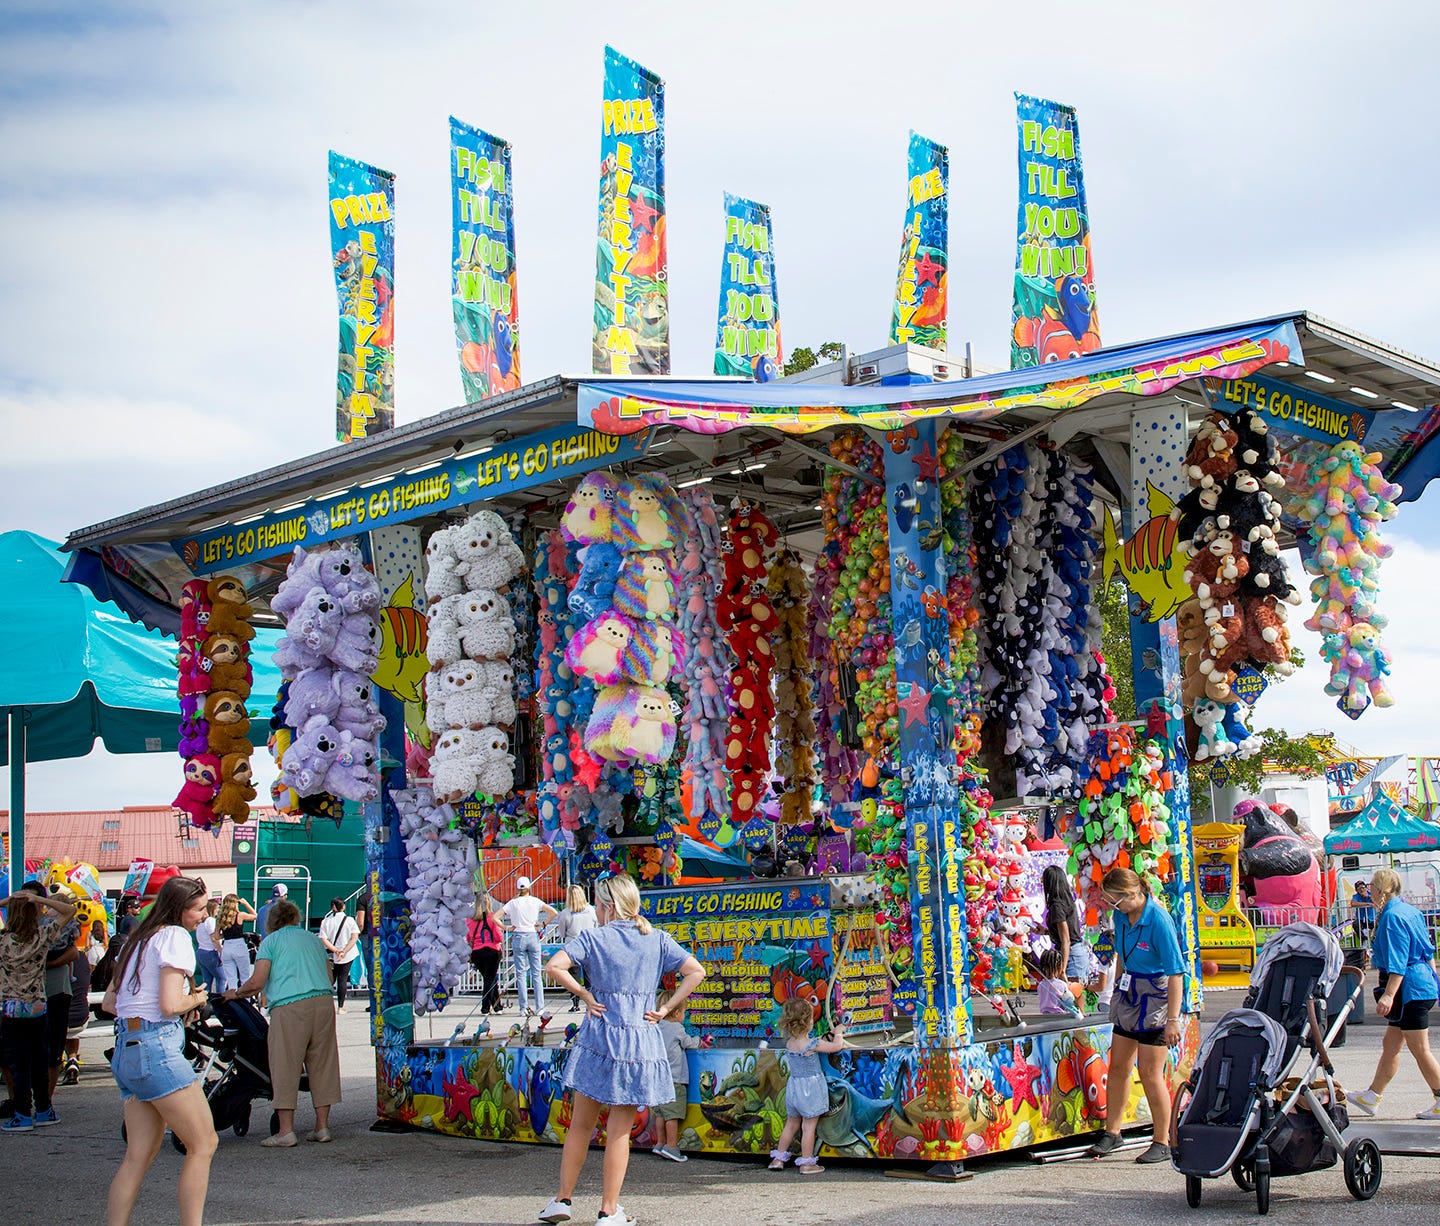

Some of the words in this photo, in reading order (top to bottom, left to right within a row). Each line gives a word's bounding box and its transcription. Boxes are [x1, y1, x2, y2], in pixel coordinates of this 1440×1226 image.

[602, 99, 659, 136] PRIZE
[1023, 120, 1076, 160] FISH
[456, 146, 506, 195] FISH
[909, 167, 947, 205] RIZE
[1026, 162, 1078, 199] TILL
[330, 192, 391, 229] PRIZE
[459, 191, 506, 232] TILL
[1025, 202, 1083, 239] YOU
[459, 230, 508, 273] YOU
[725, 214, 769, 253] FISH
[605, 142, 637, 374] EVERYTIME
[727, 252, 771, 286] TILL
[1021, 245, 1088, 279] WIN!
[457, 271, 512, 315] WIN!
[898, 212, 923, 344] EVERYT
[726, 287, 772, 321] YOU
[350, 230, 377, 439] EVERYTIME
[723, 325, 777, 358] WIN!
[1224, 379, 1267, 412] LET'S
[1268, 391, 1293, 419] GO
[1294, 399, 1350, 438] FISHING
[477, 448, 521, 488] LET'S
[522, 440, 547, 476] GO
[550, 427, 620, 468] FISHING
[330, 498, 367, 530] LET'S
[368, 488, 392, 519] GO
[392, 472, 451, 512] FISHING
[203, 532, 235, 565] LET'S
[235, 525, 256, 557] GO
[257, 514, 308, 554] FISHING
[1237, 675, 1262, 687] EXTRA
[1237, 683, 1263, 695] LARGE
[656, 831, 674, 841] LARGE
[700, 820, 720, 830] LARGE
[744, 828, 769, 839] LARGE
[787, 835, 807, 844] LARGE
[914, 822, 930, 894] PRIZE
[943, 820, 959, 893] PRIZE
[1177, 820, 1191, 882] PRIZE
[371, 871, 382, 927] PRIZE
[656, 896, 694, 915] LET'S
[696, 894, 719, 912] GO
[721, 891, 783, 911] FISHING
[695, 917, 829, 942] EVERYTIME
[1183, 892, 1200, 1003] EVERYTIME
[696, 946, 735, 962] GAME
[721, 964, 770, 977] MEDIUM
[919, 906, 940, 1037] EVERYTIME
[948, 904, 971, 1036] EVERYTIME
[373, 935, 385, 1038] EVERYTIME
[694, 981, 724, 993] AMES
[731, 980, 771, 993] LARGE
[893, 991, 918, 1000] MEDIU
[690, 1013, 705, 1024] ONE
[705, 1013, 722, 1024] FISH
[723, 1013, 737, 1024] PER
[738, 1013, 761, 1024] GAME
